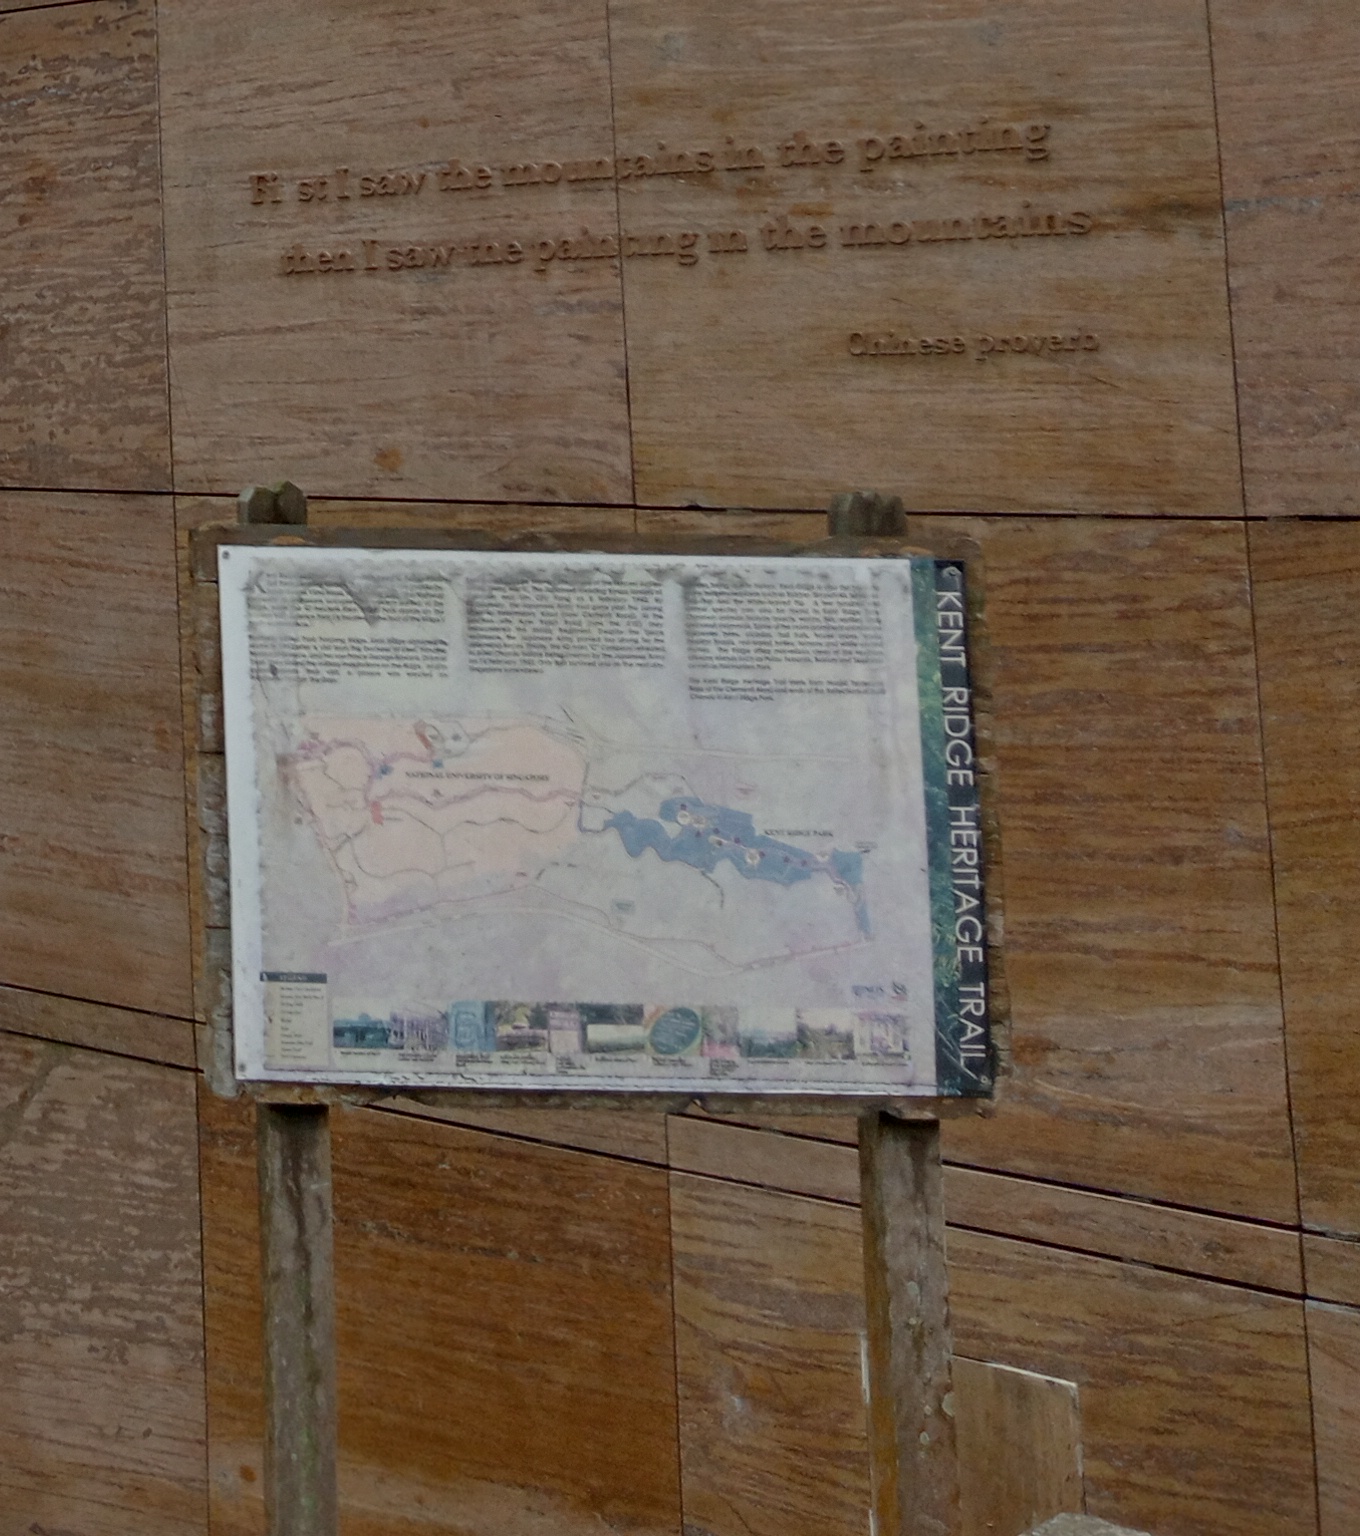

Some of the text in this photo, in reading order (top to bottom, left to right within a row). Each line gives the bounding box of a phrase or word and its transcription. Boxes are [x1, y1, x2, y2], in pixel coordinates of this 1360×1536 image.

[249, 117, 1052, 204] Fist I saw the mountains in the painting
[281, 241, 355, 276] then
[361, 238, 380, 271] I
[384, 244, 456, 272] saw
[530, 225, 700, 274] painting
[759, 214, 827, 251] the
[839, 199, 1092, 248] mountains
[849, 326, 1100, 362] Chinese proverb
[936, 591, 987, 1069] KENT RIDGE HERITAGE TRAIL
